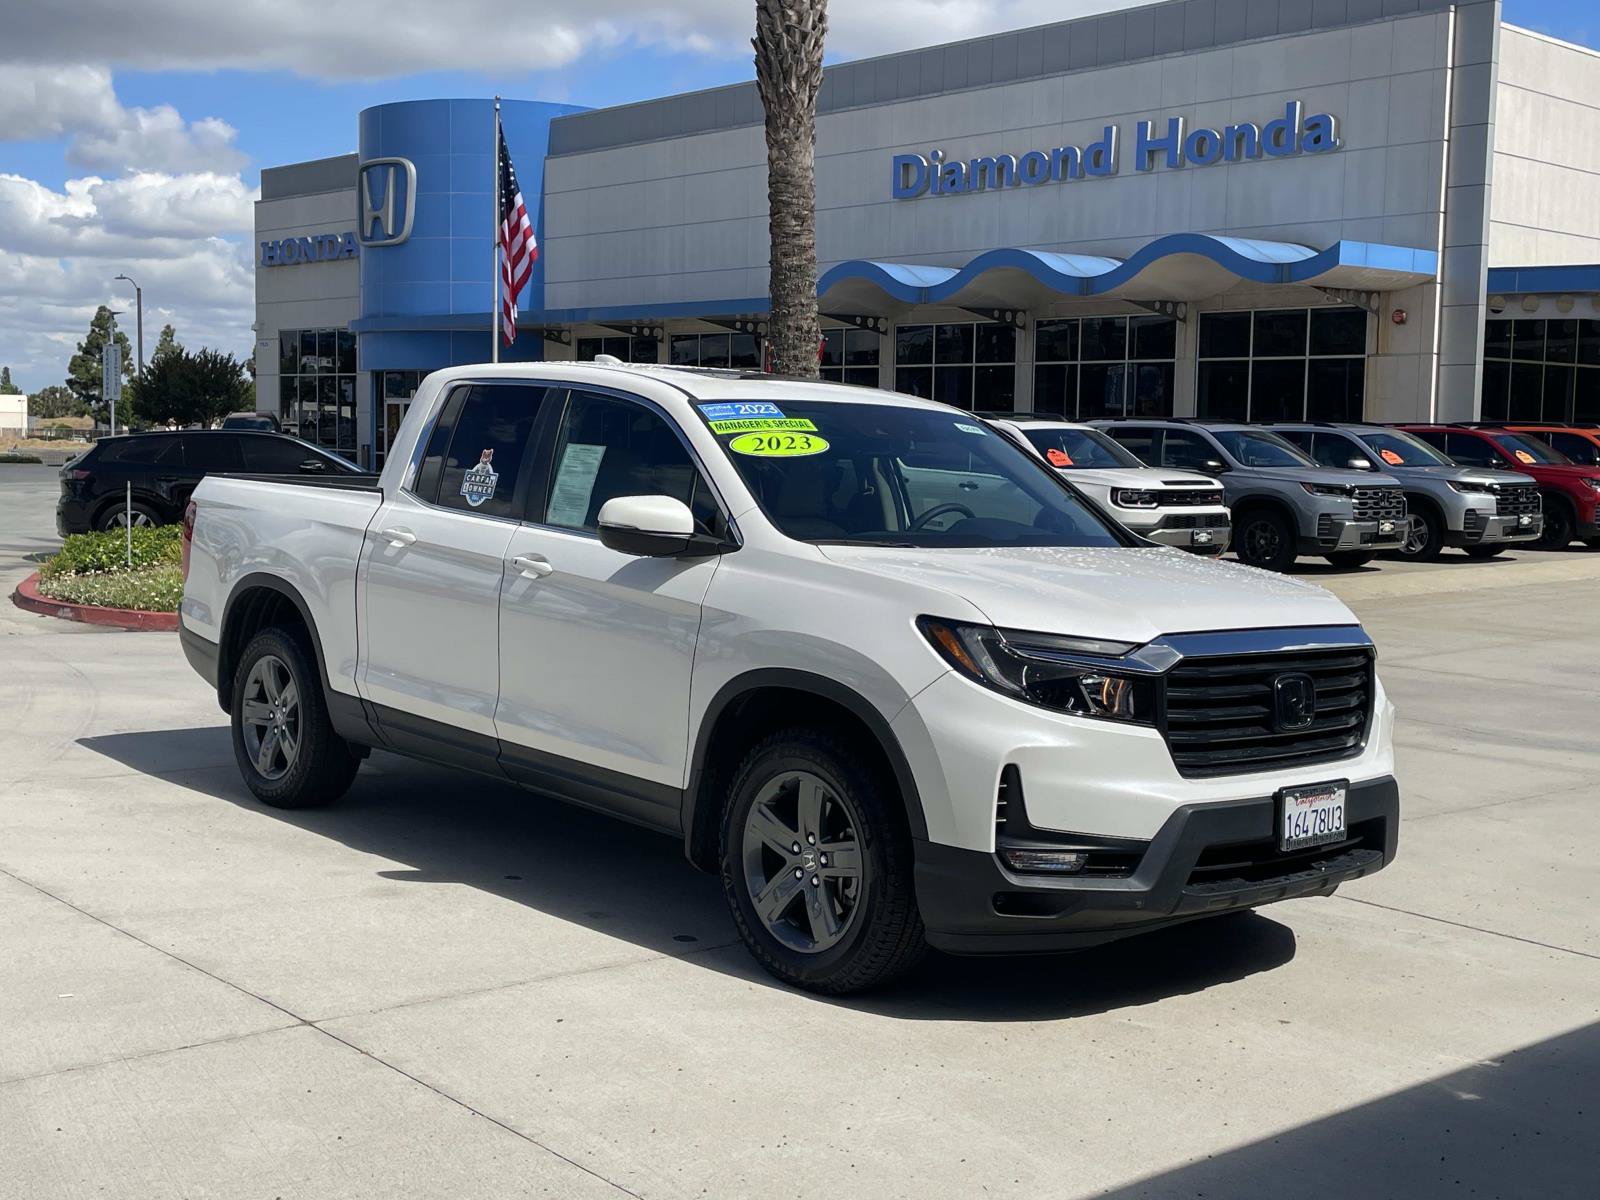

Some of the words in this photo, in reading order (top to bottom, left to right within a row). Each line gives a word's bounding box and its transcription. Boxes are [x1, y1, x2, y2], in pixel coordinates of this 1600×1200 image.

[892, 124, 1118, 200] Diamond
[1135, 100, 1343, 172] Honda
[260, 232, 360, 267] HONDA
[734, 404, 778, 415] 2023
[714, 421, 772, 431] MANAGER'S
[774, 420, 812, 428] SPECIAL
[751, 436, 812, 451] 2023
[1287, 805, 1343, 839] 16478U3
